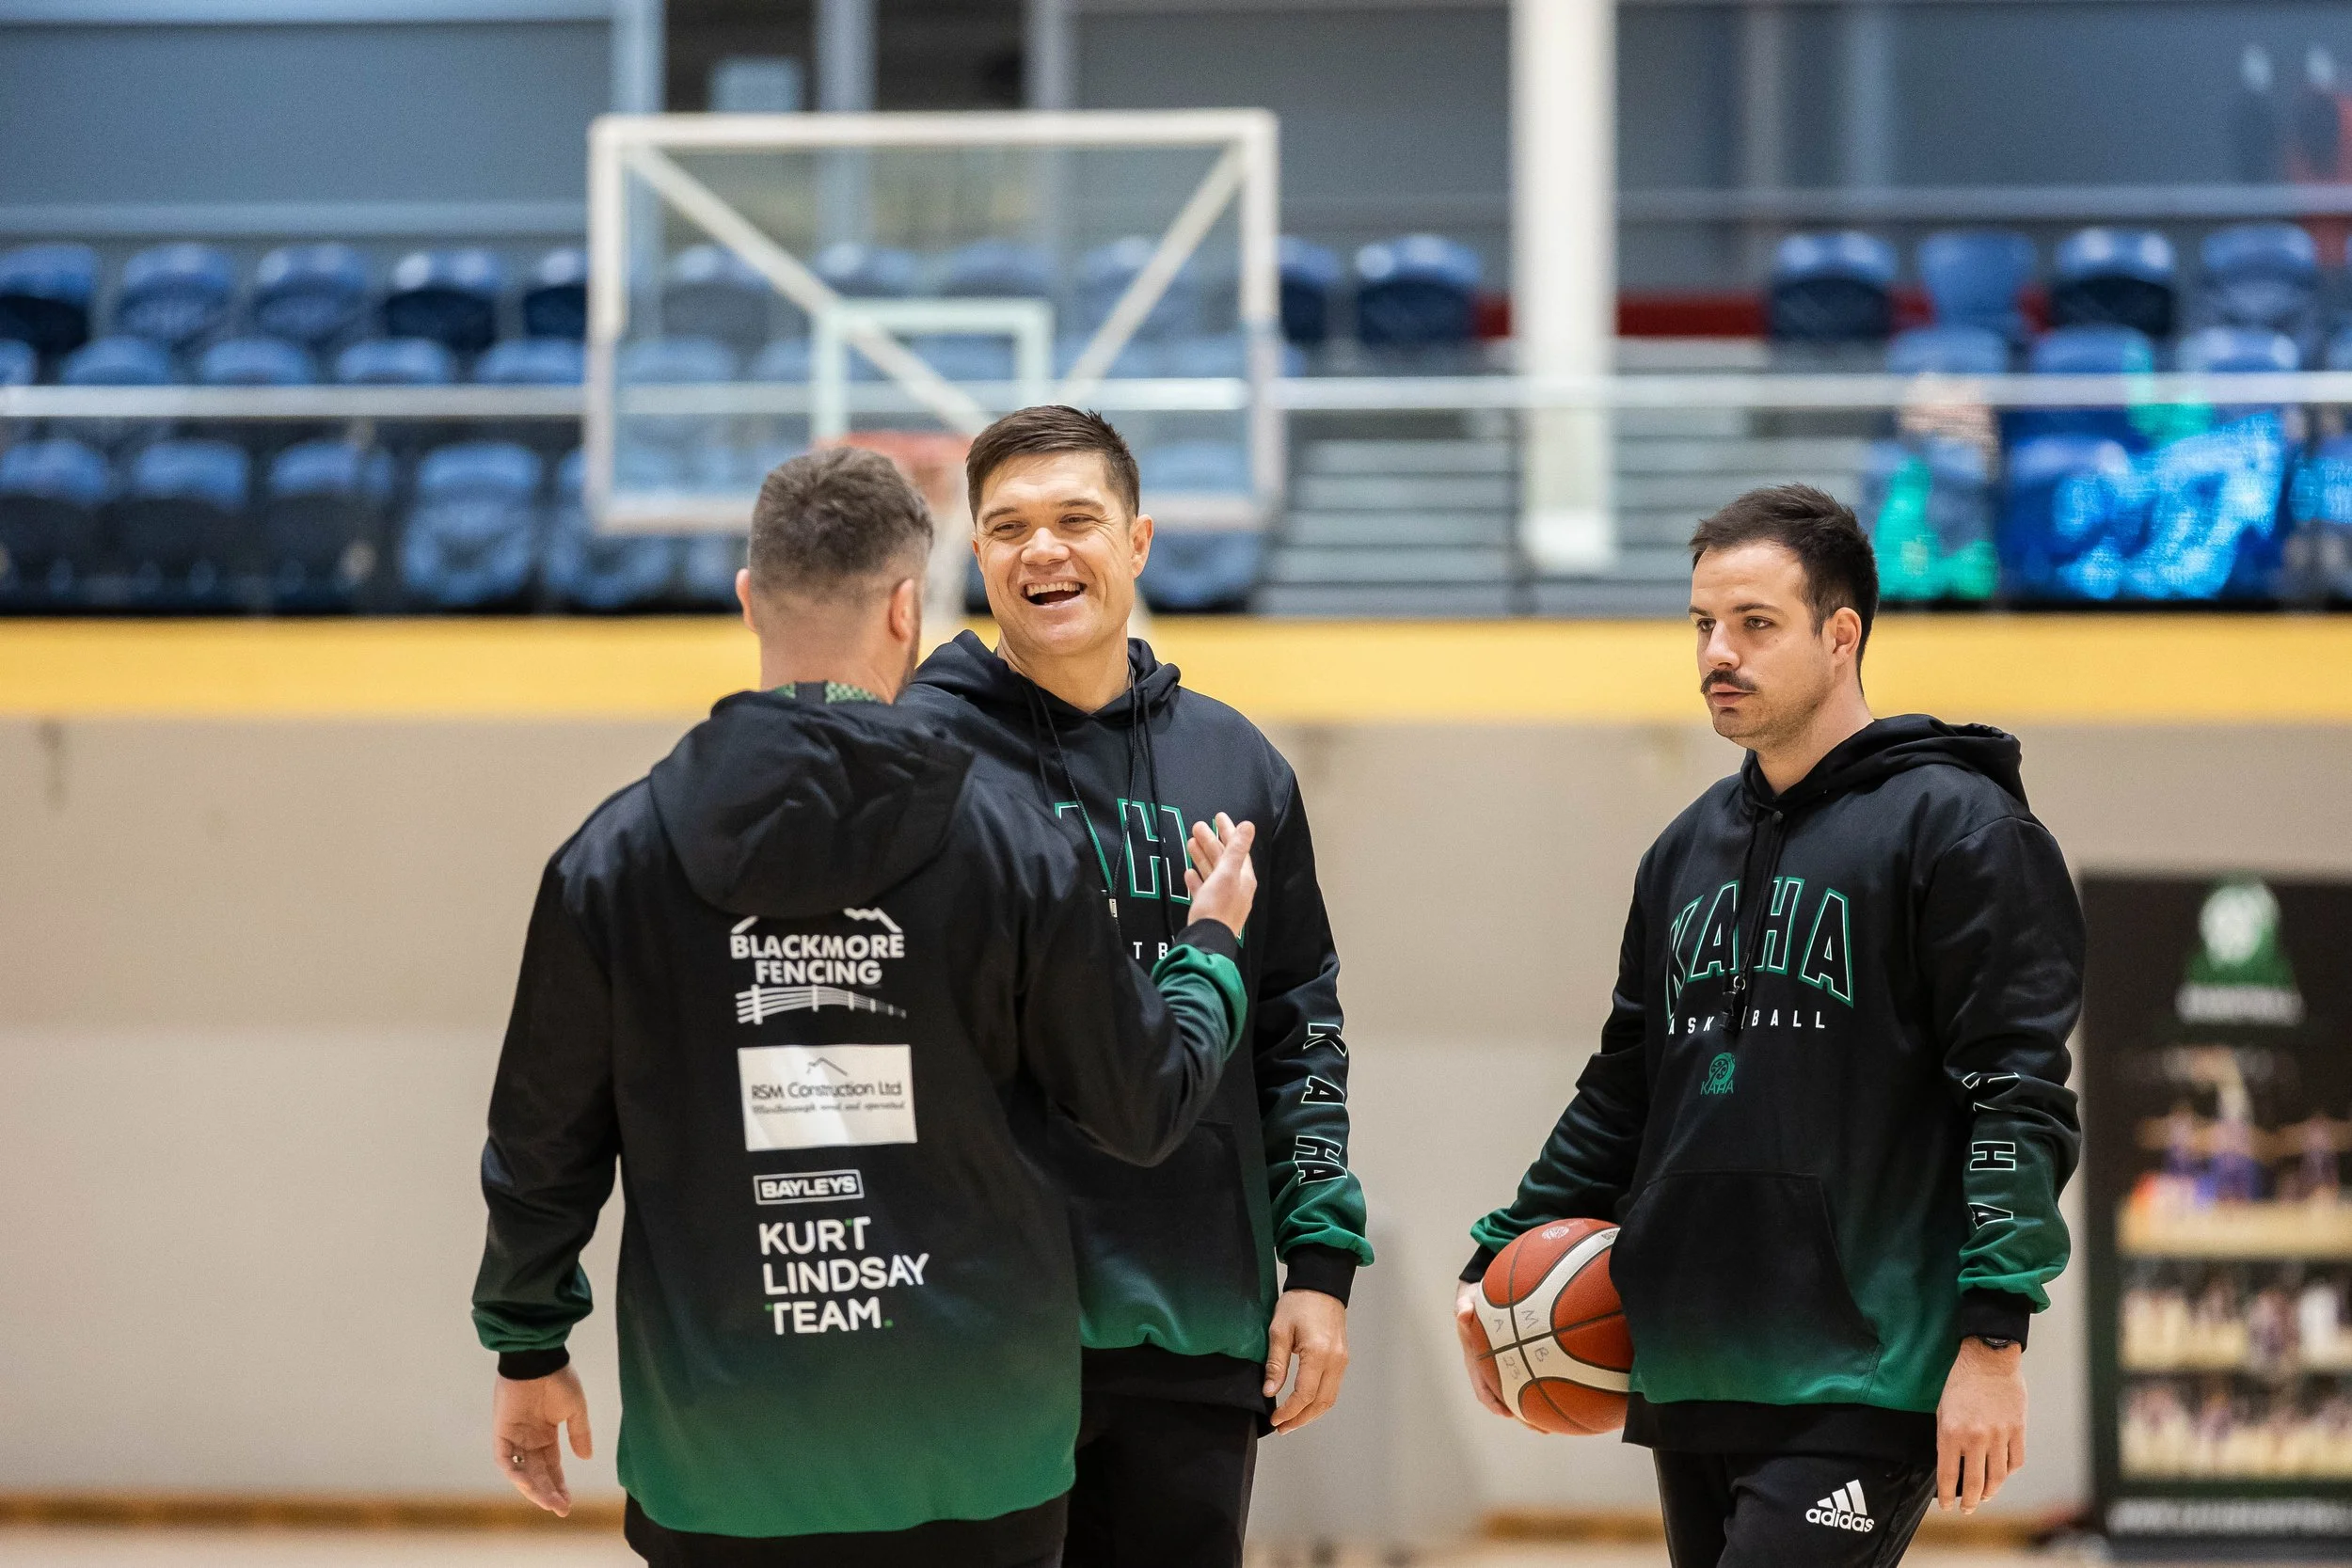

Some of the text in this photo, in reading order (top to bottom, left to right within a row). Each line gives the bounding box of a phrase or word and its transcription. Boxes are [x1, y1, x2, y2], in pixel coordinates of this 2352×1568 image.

[730, 933, 905, 959] BLACKMORE
[755, 959, 882, 985] FENCING
[752, 1081, 902, 1100] RSM Construction Ltd
[1700, 1080, 1734, 1095] KAHA
[760, 1176, 857, 1198] BAYLEYS
[759, 1216, 871, 1256] KURT
[763, 1253, 930, 1295] LINDSAY
[1805, 1508, 1874, 1532] adidas
